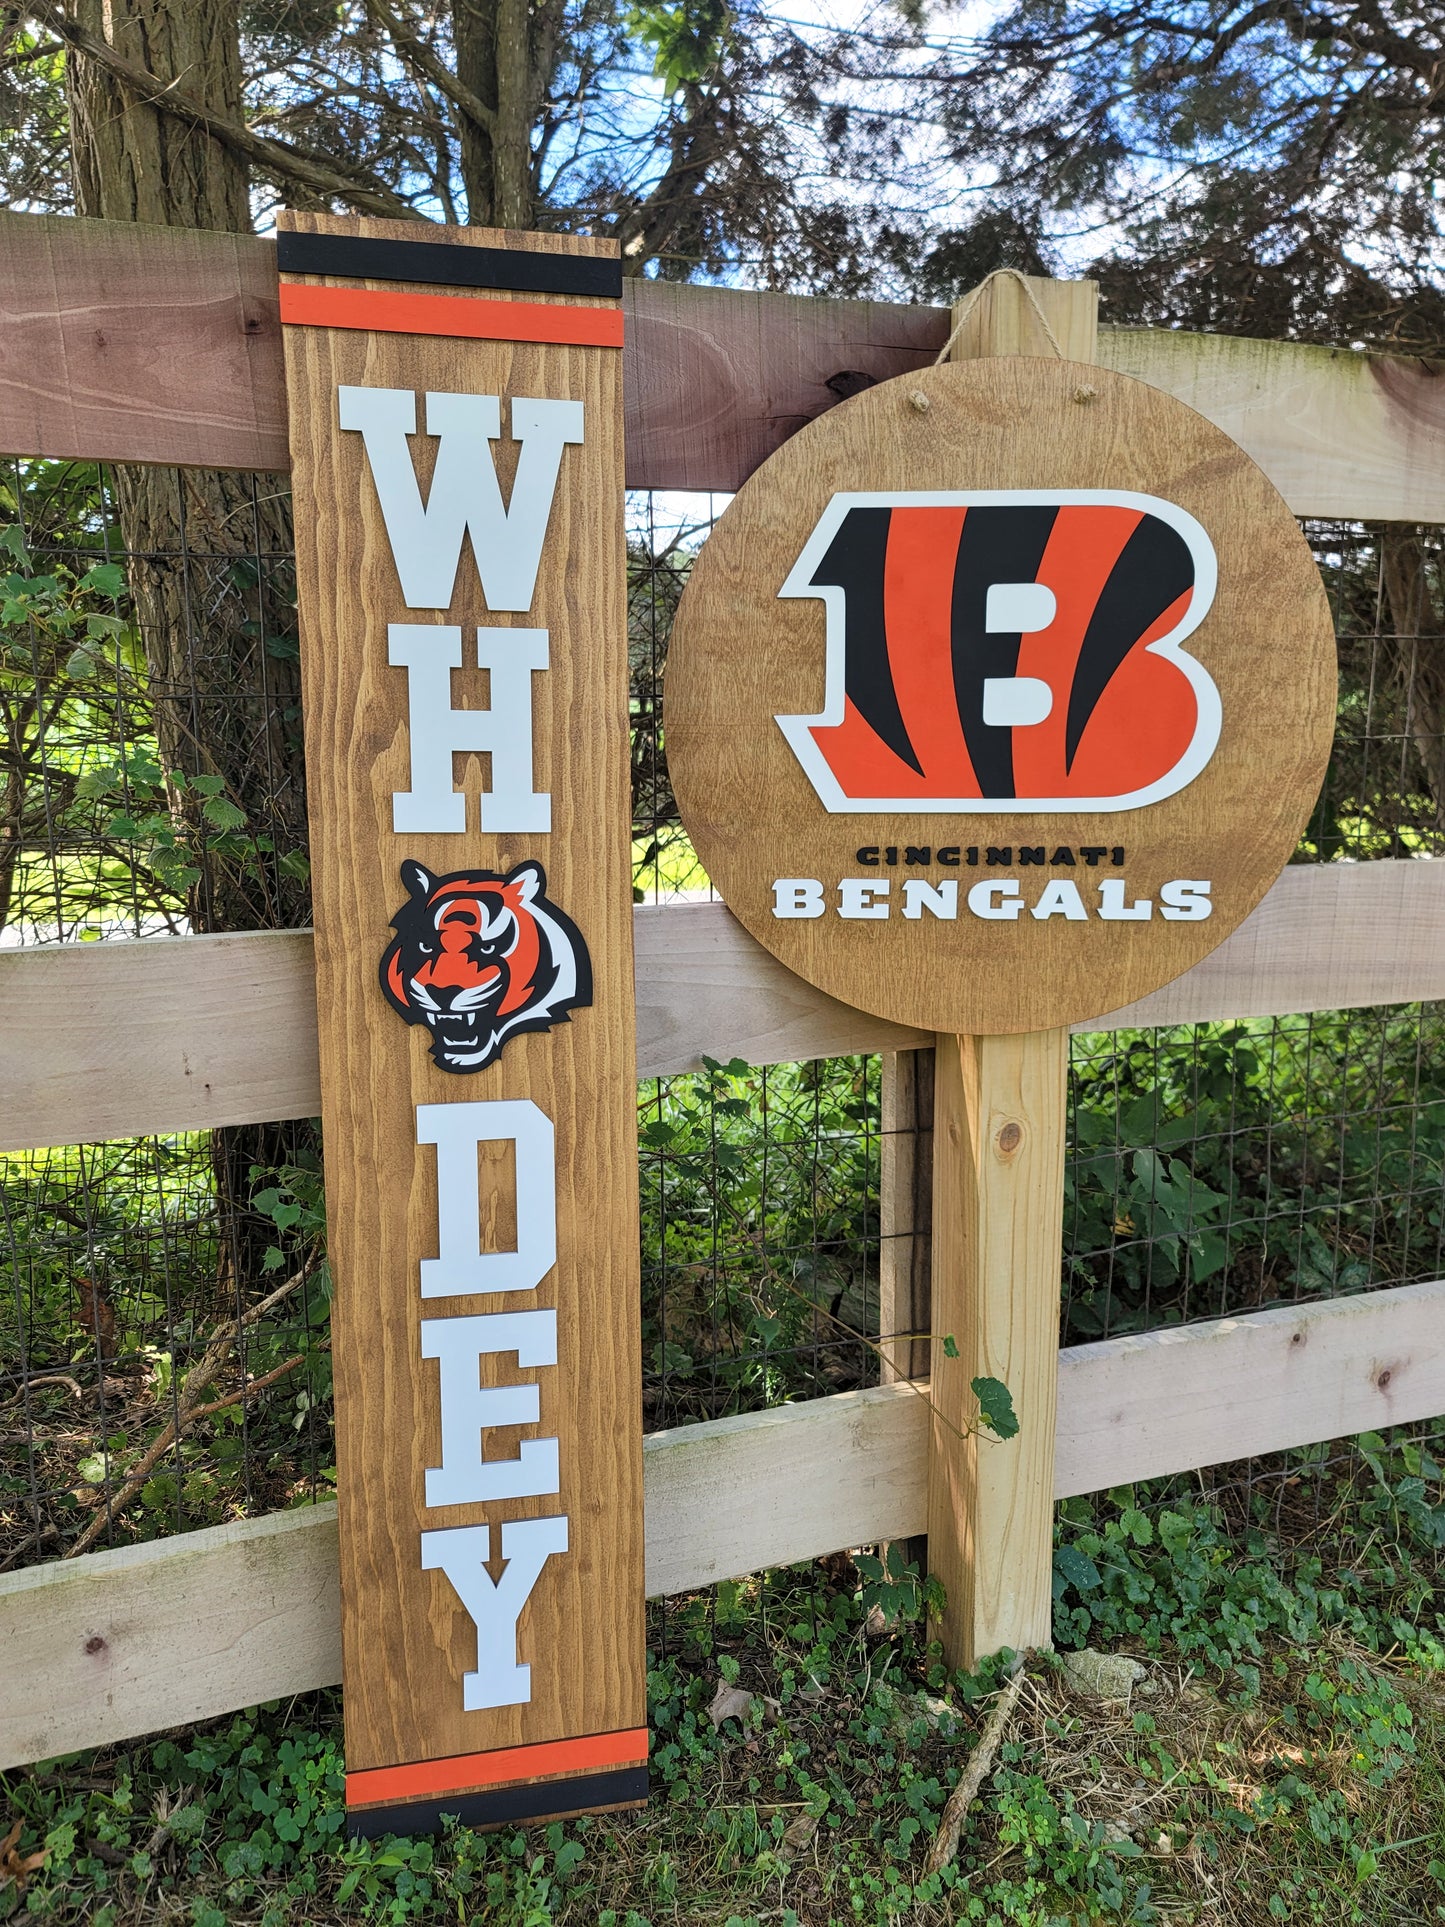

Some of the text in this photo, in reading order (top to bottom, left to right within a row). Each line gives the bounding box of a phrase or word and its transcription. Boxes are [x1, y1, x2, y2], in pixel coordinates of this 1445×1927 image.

[774, 490, 1222, 813] B
[771, 878, 1213, 921] BENGALS
[857, 846, 1125, 866] CINCINNATI
[416, 1100, 569, 1711] DEY
